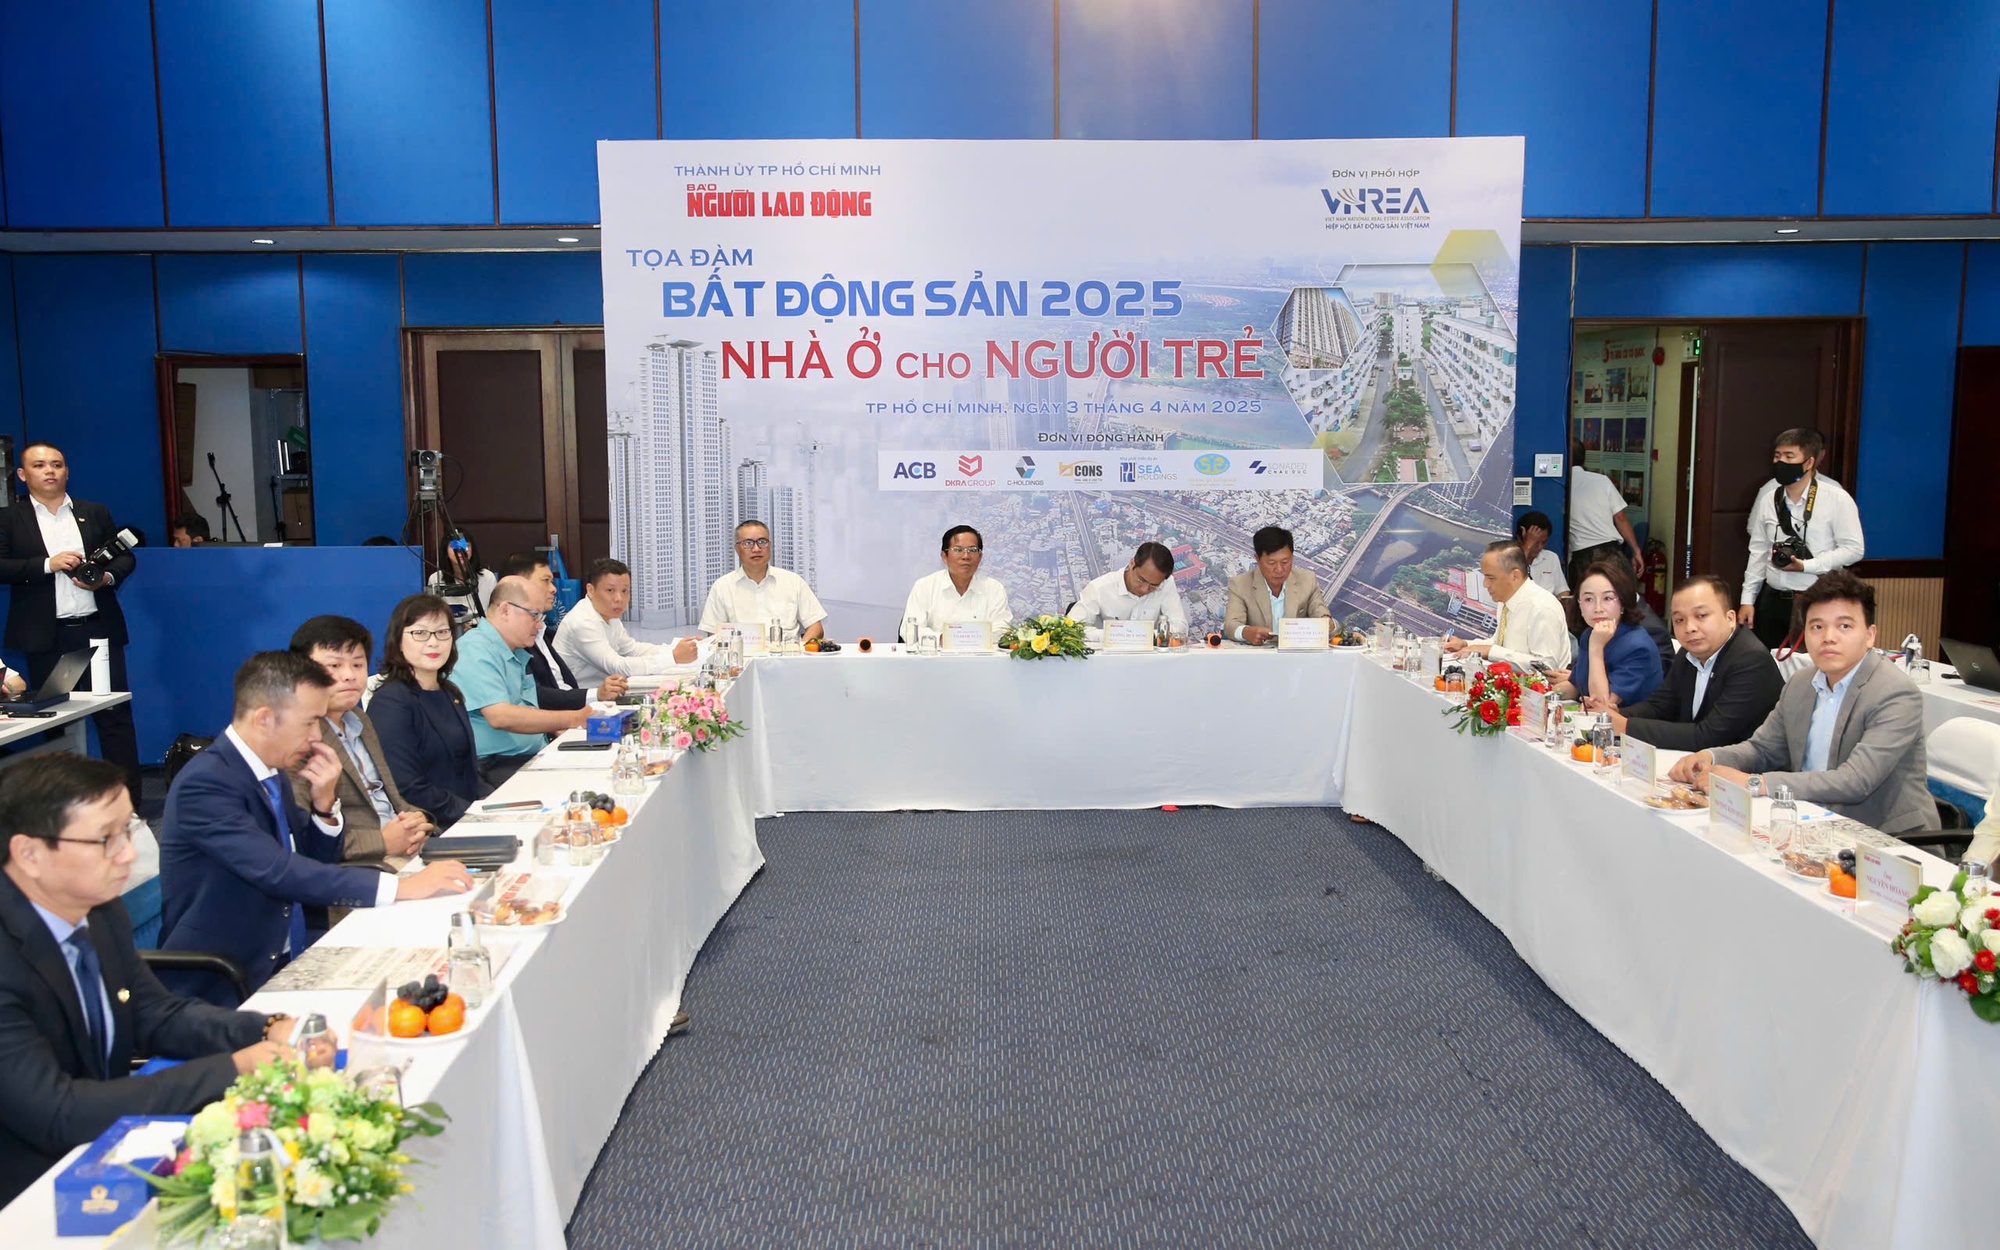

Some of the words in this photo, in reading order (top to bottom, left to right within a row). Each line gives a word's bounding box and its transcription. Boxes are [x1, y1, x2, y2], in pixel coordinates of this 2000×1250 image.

[674, 163, 730, 176] THÀNH
[734, 162, 754, 176] ỦY
[758, 165, 778, 176] TP
[782, 161, 805, 176] HỒ
[808, 162, 836, 175] CHÍ
[840, 165, 881, 176] MINH
[1332, 169, 1355, 178] ĐƠN
[1359, 170, 1368, 179] VỊ
[1371, 167, 1395, 177] PHỐI
[1398, 169, 1420, 179] HỢP
[687, 189, 755, 217] NGƯỜI
[762, 191, 804, 217] LAO
[810, 189, 872, 218] ĐỘNG
[1321, 188, 1430, 214] VNREA
[626, 249, 684, 271] TỌA
[690, 244, 753, 267] ĐÀM
[663, 267, 766, 317] BẤT
[776, 273, 914, 324] ĐỘNG
[924, 270, 1029, 317] SẢN
[1041, 280, 1183, 317] 2025
[721, 329, 834, 379] NHÀ
[846, 326, 883, 379] Ở
[896, 352, 971, 379] CHO
[985, 329, 1150, 379] NGƯỜI
[1163, 325, 1264, 379] TRẺ
[866, 403, 888, 414] TP
[892, 398, 918, 414] HỒ
[922, 400, 952, 414] CHÍ
[1014, 400, 1061, 414] NGÀY
[1066, 401, 1078, 414] 3
[1084, 400, 1145, 414] THÁNG
[1149, 400, 1162, 414] 4
[1167, 399, 1206, 413] NĂM
[1211, 400, 1262, 413] 2025
[1038, 432, 1067, 442] ĐƠN
[1071, 433, 1083, 444] VỊ
[1086, 431, 1124, 442] ĐỒNG
[1127, 432, 1164, 442] HÀNH
[893, 461, 937, 479] ACB
[1138, 465, 1162, 474] SEA
